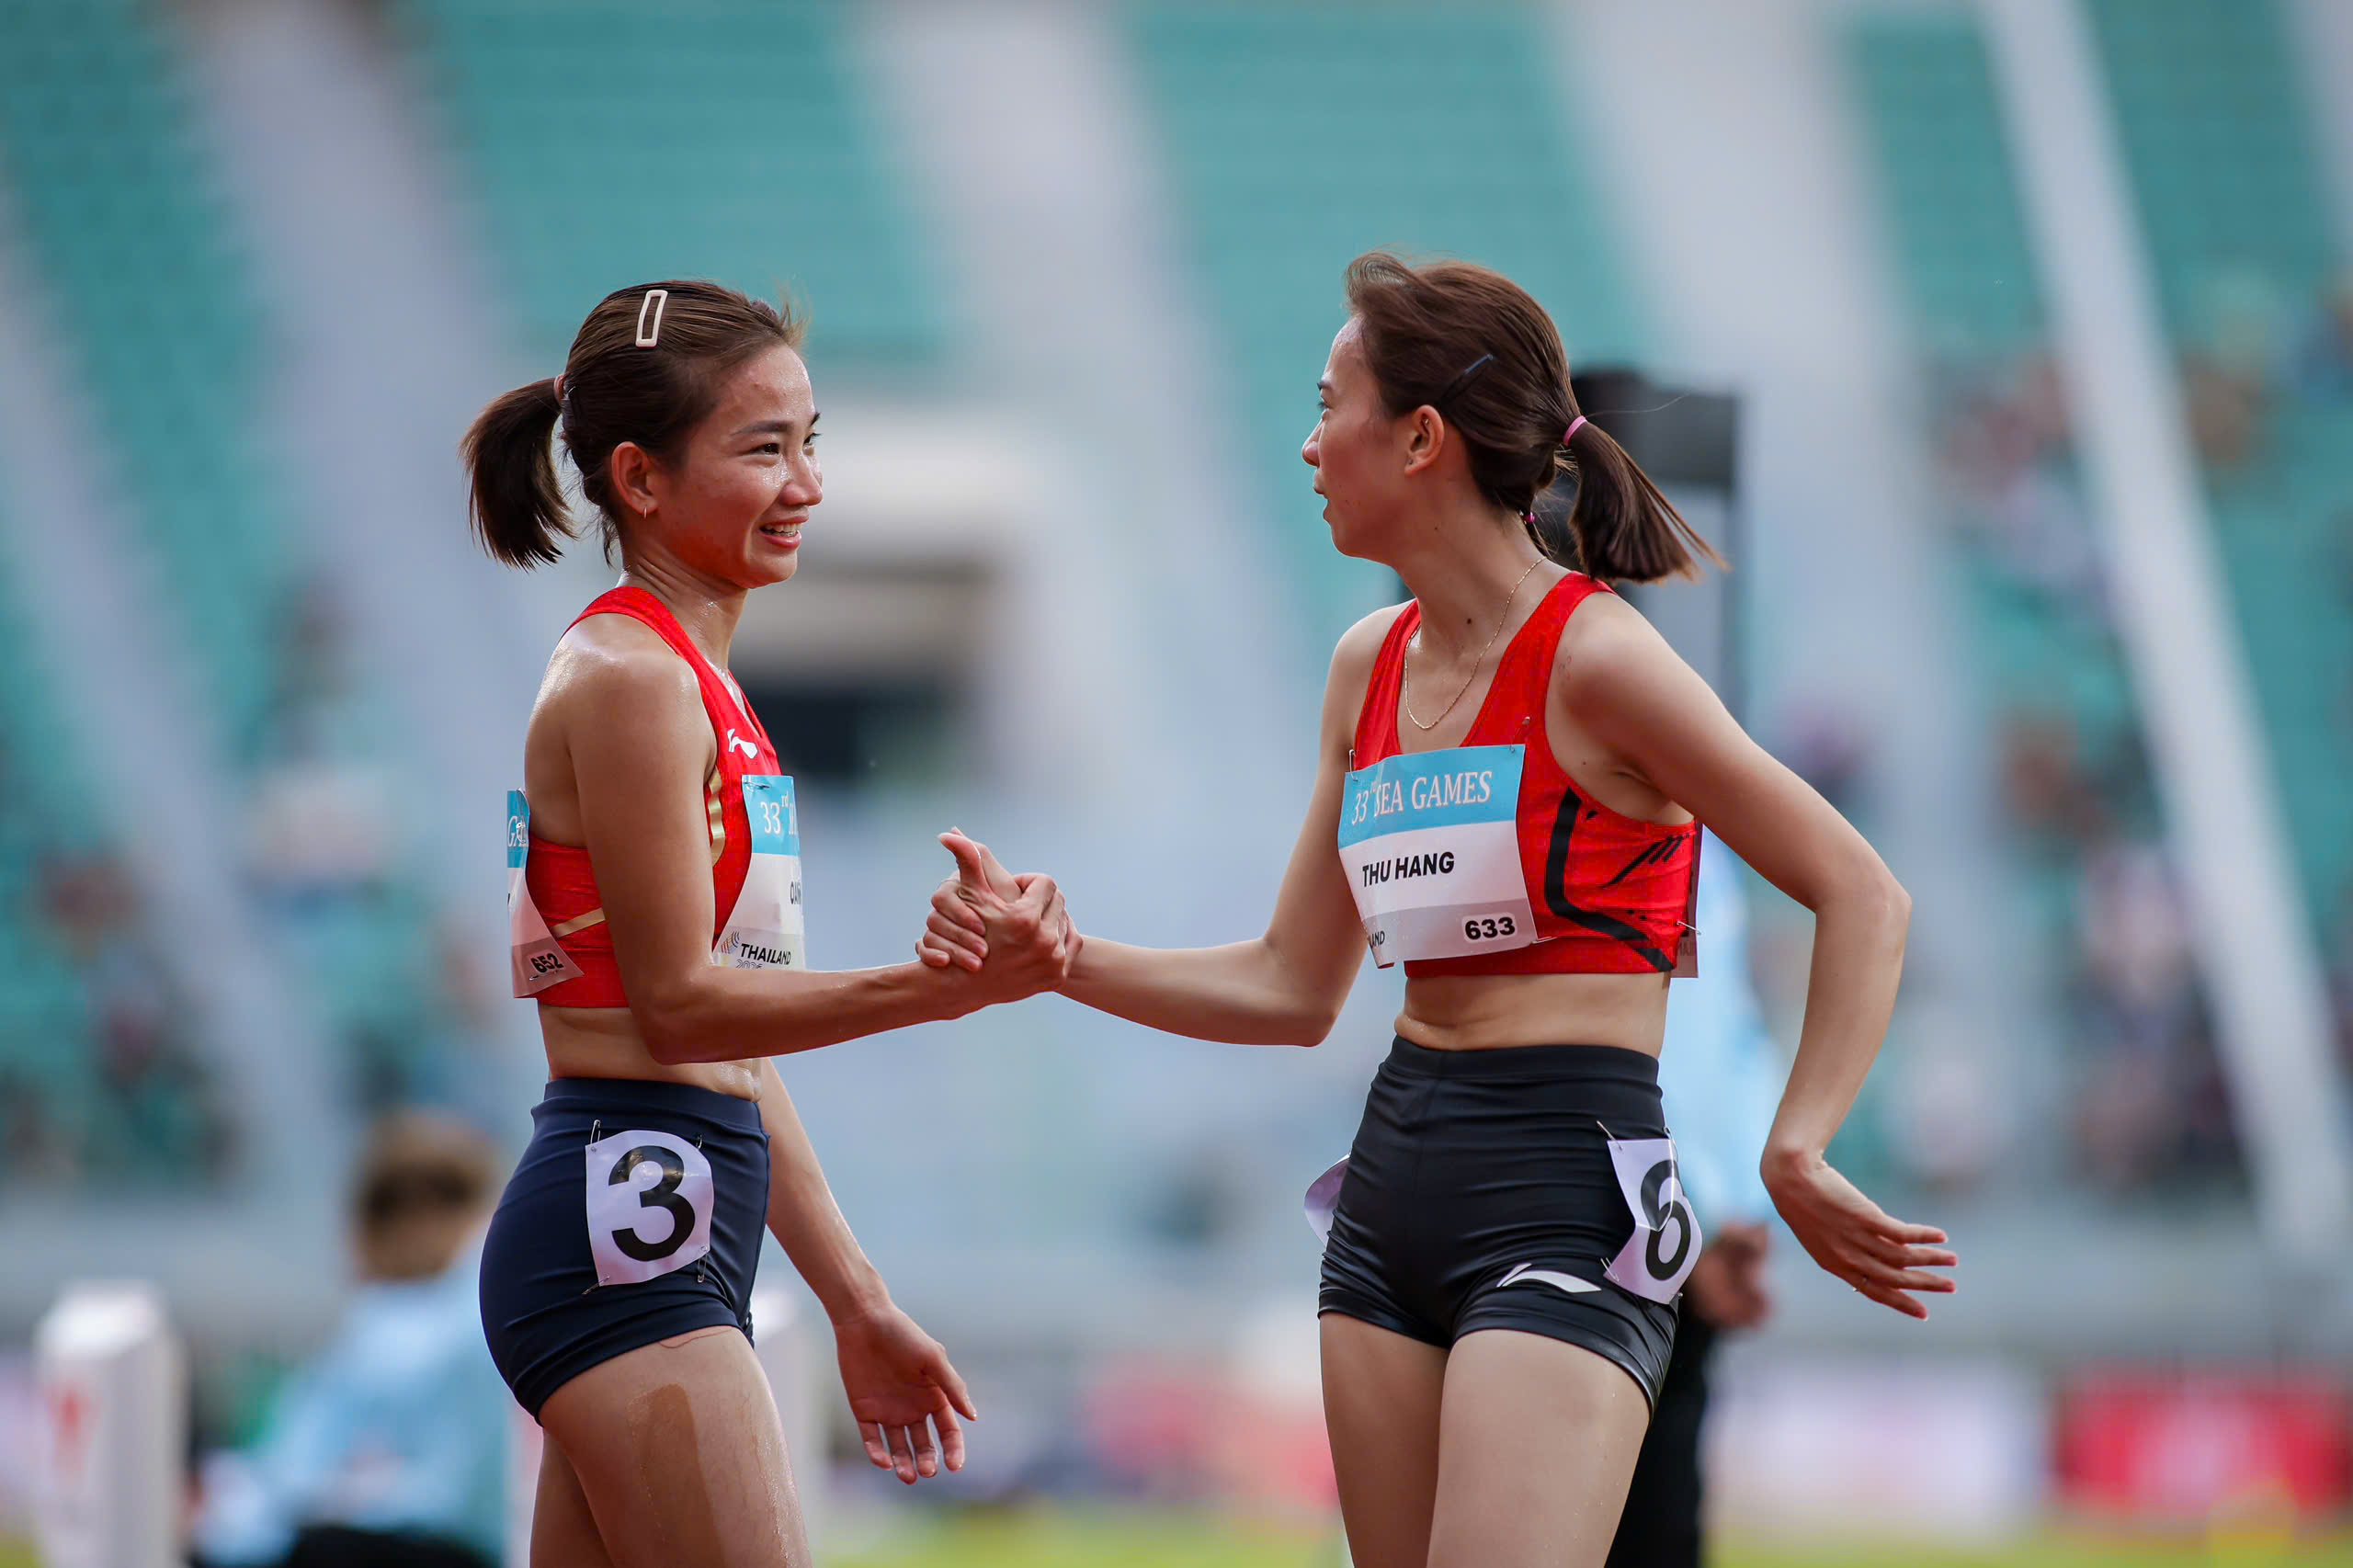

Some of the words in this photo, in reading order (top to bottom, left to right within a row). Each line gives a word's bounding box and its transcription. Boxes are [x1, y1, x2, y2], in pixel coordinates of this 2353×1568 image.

[1412, 770, 1493, 810] GAMES
[1362, 859, 1391, 887] THU
[1394, 851, 1455, 880] HANG
[1464, 916, 1516, 940] 633
[530, 953, 564, 973] 652
[741, 943, 791, 965] THAILAND
[608, 1145, 696, 1262] 3
[1640, 1159, 1691, 1281] 6
